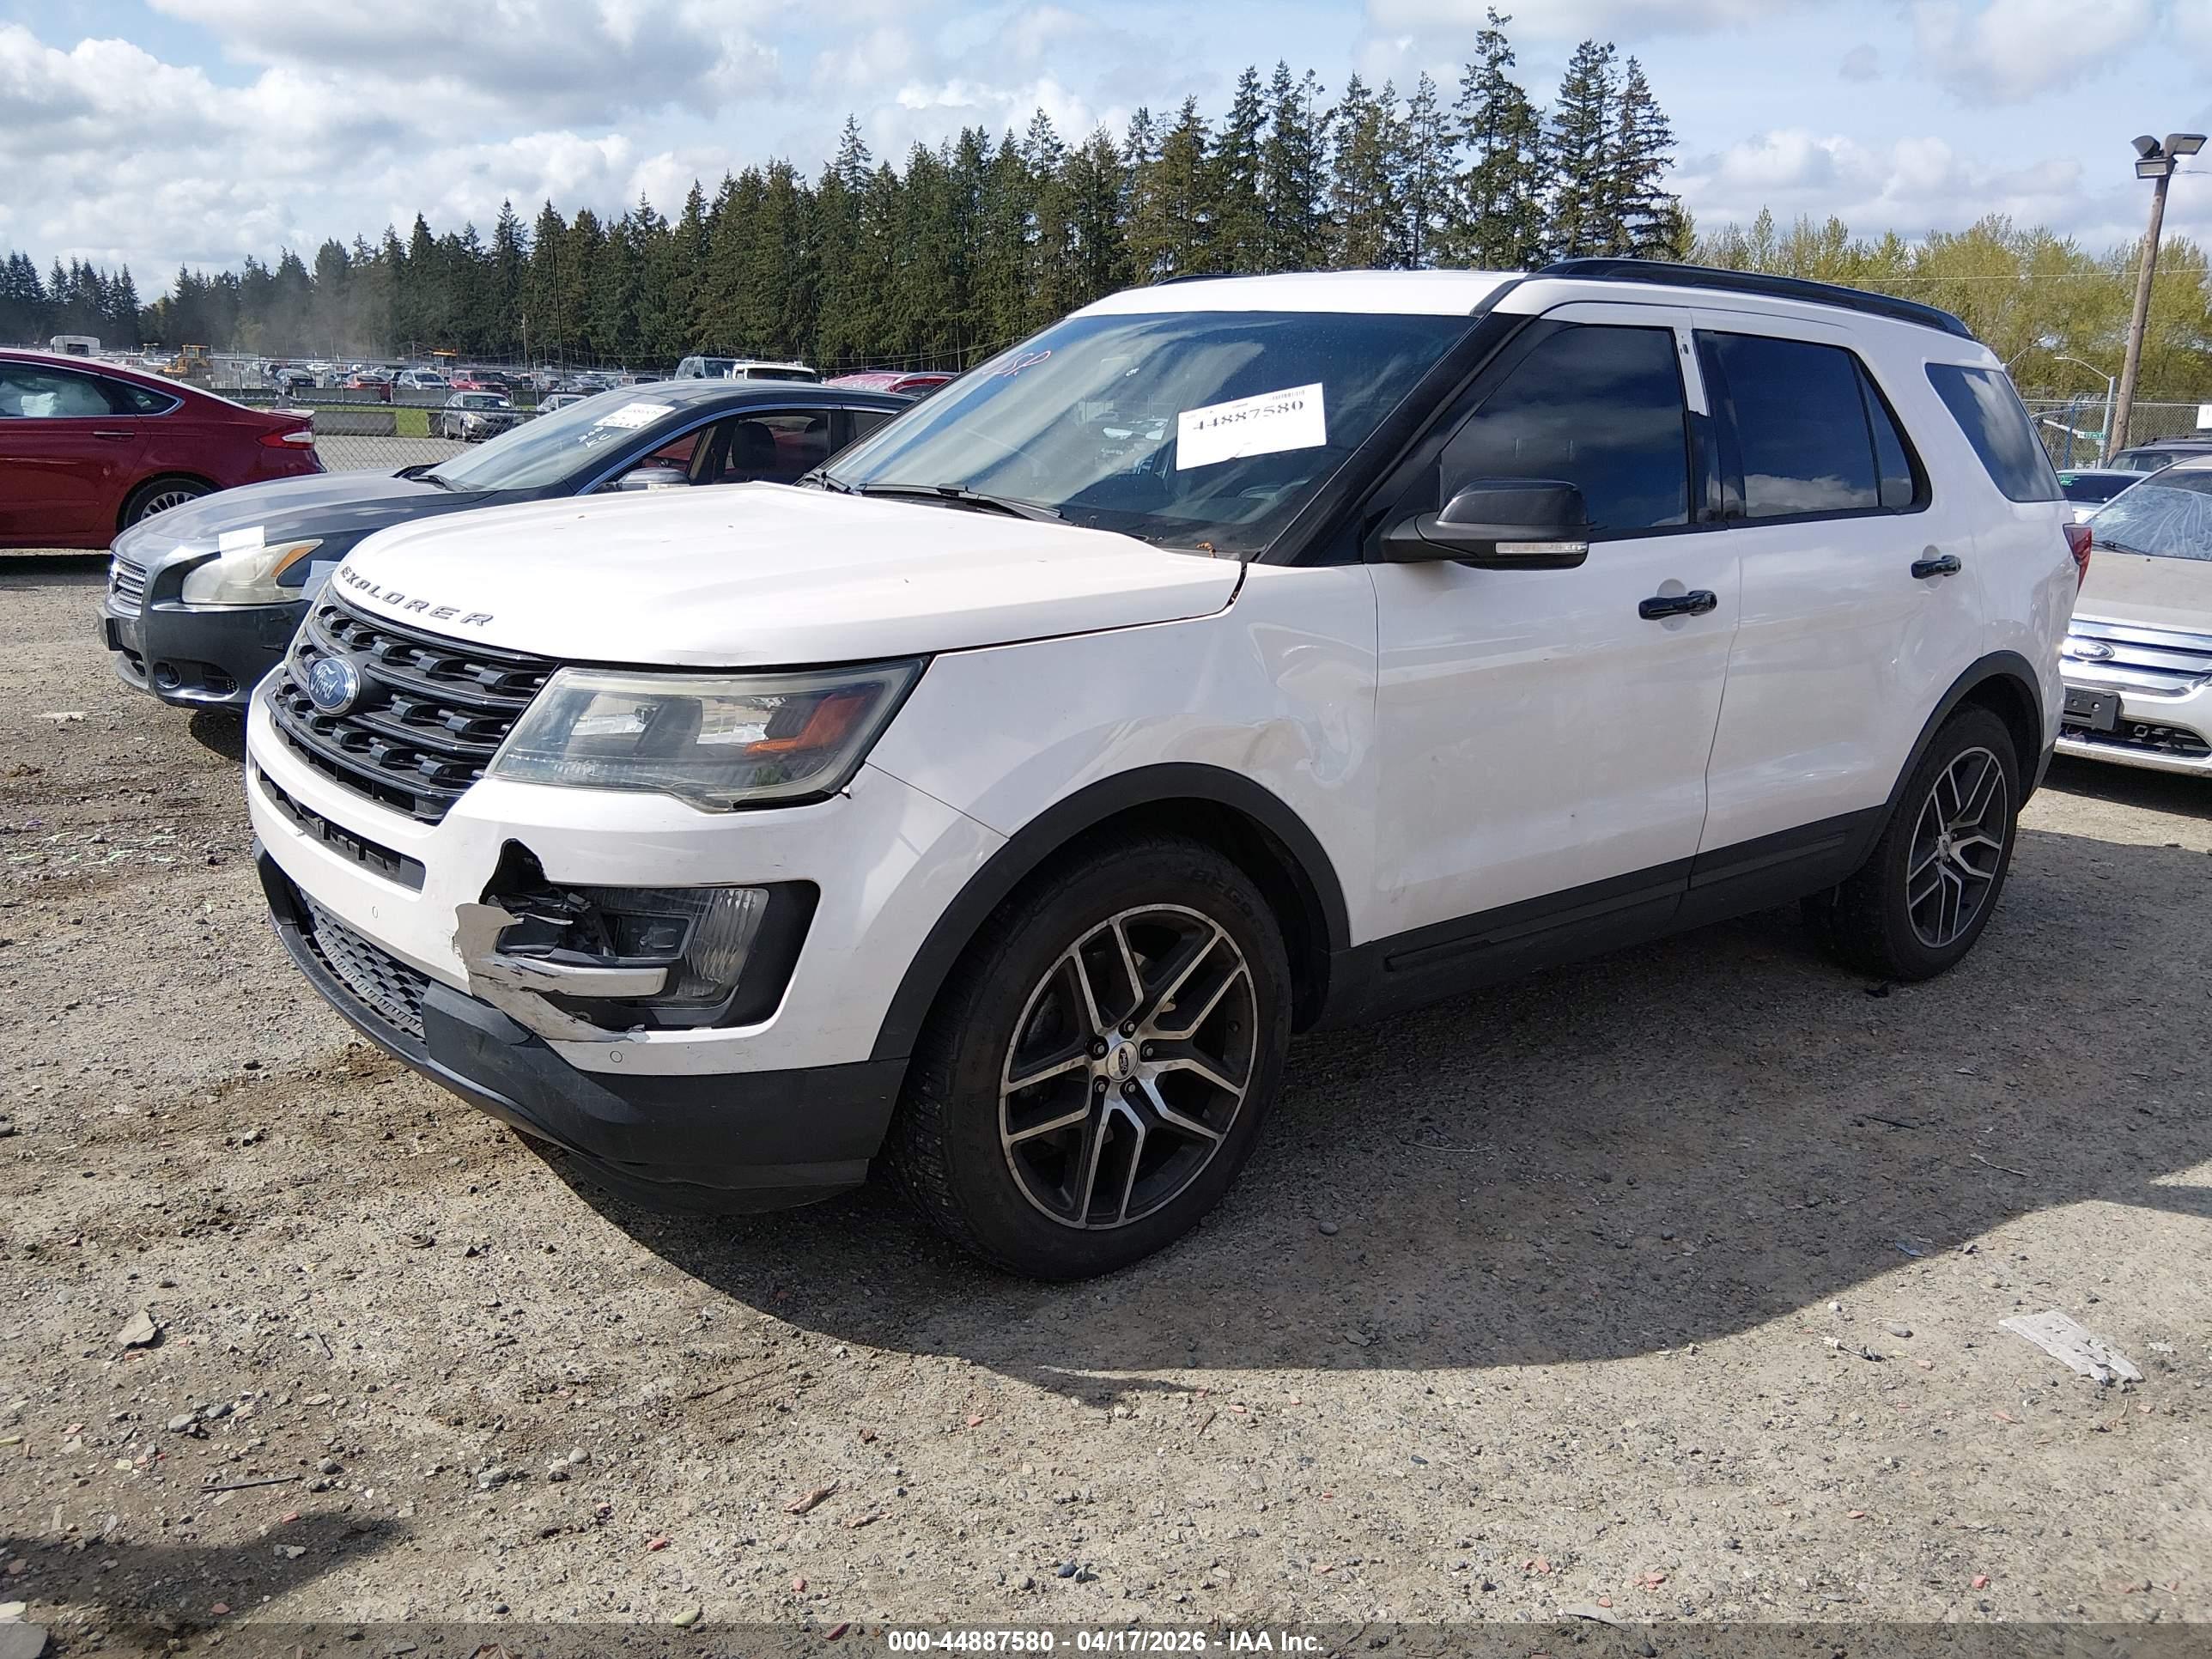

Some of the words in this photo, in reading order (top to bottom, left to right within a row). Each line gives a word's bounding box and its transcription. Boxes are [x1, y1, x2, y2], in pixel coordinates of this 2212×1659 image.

[1194, 400, 1304, 430] 44887580
[339, 566, 495, 628] EXPLORER
[310, 664, 339, 700] Ford
